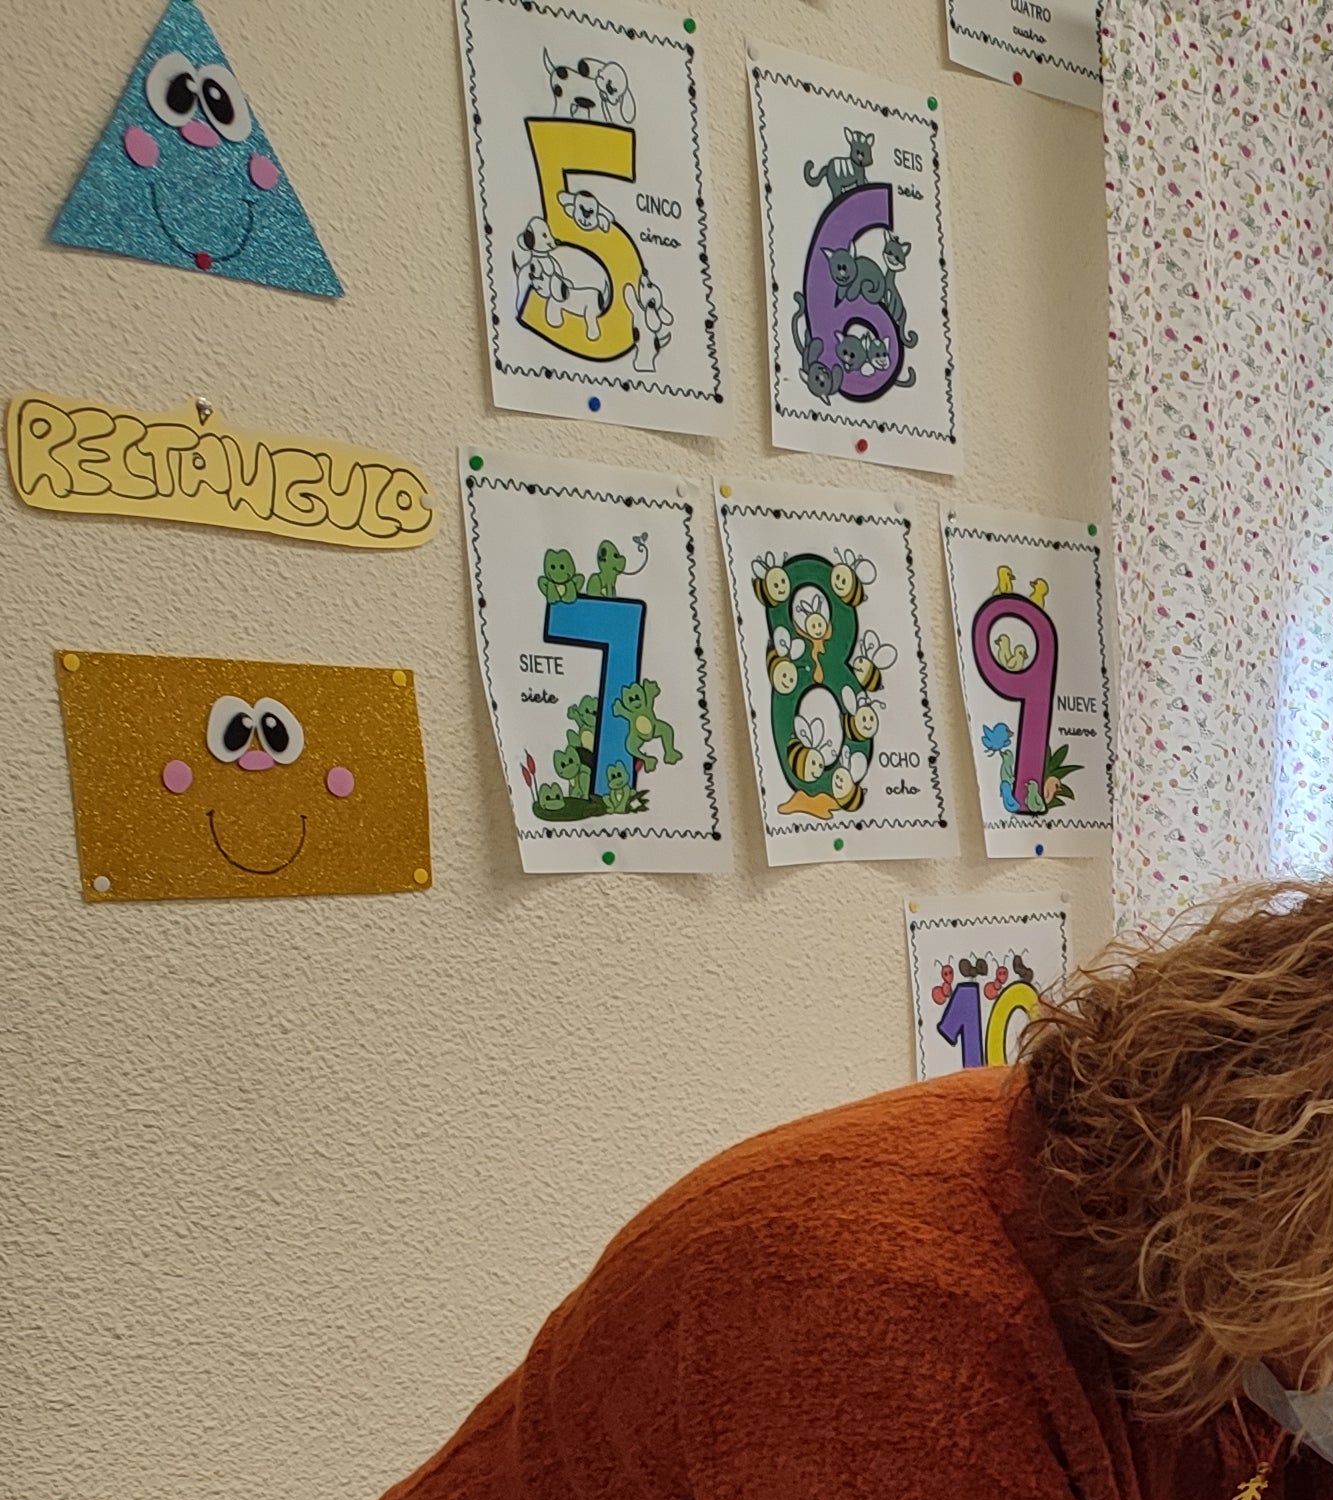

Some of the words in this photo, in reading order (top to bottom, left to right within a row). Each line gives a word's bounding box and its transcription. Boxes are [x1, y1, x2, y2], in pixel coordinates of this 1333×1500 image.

[1012, 25, 1047, 44] cuatro
[893, 148, 924, 173] SEIS
[897, 183, 924, 201] seis
[636, 192, 682, 220] CINCO
[517, 116, 645, 362] 5
[640, 227, 682, 249] cinco
[803, 182, 904, 403] 6
[519, 653, 565, 676] SIETE
[766, 553, 874, 797] 8
[521, 689, 559, 705] siete
[544, 594, 647, 800] 7
[971, 592, 1058, 815] 9
[1056, 695, 1098, 714] NUEVE
[1058, 724, 1098, 738] nueve
[878, 750, 921, 770] OCHO
[885, 779, 921, 796] ocho
